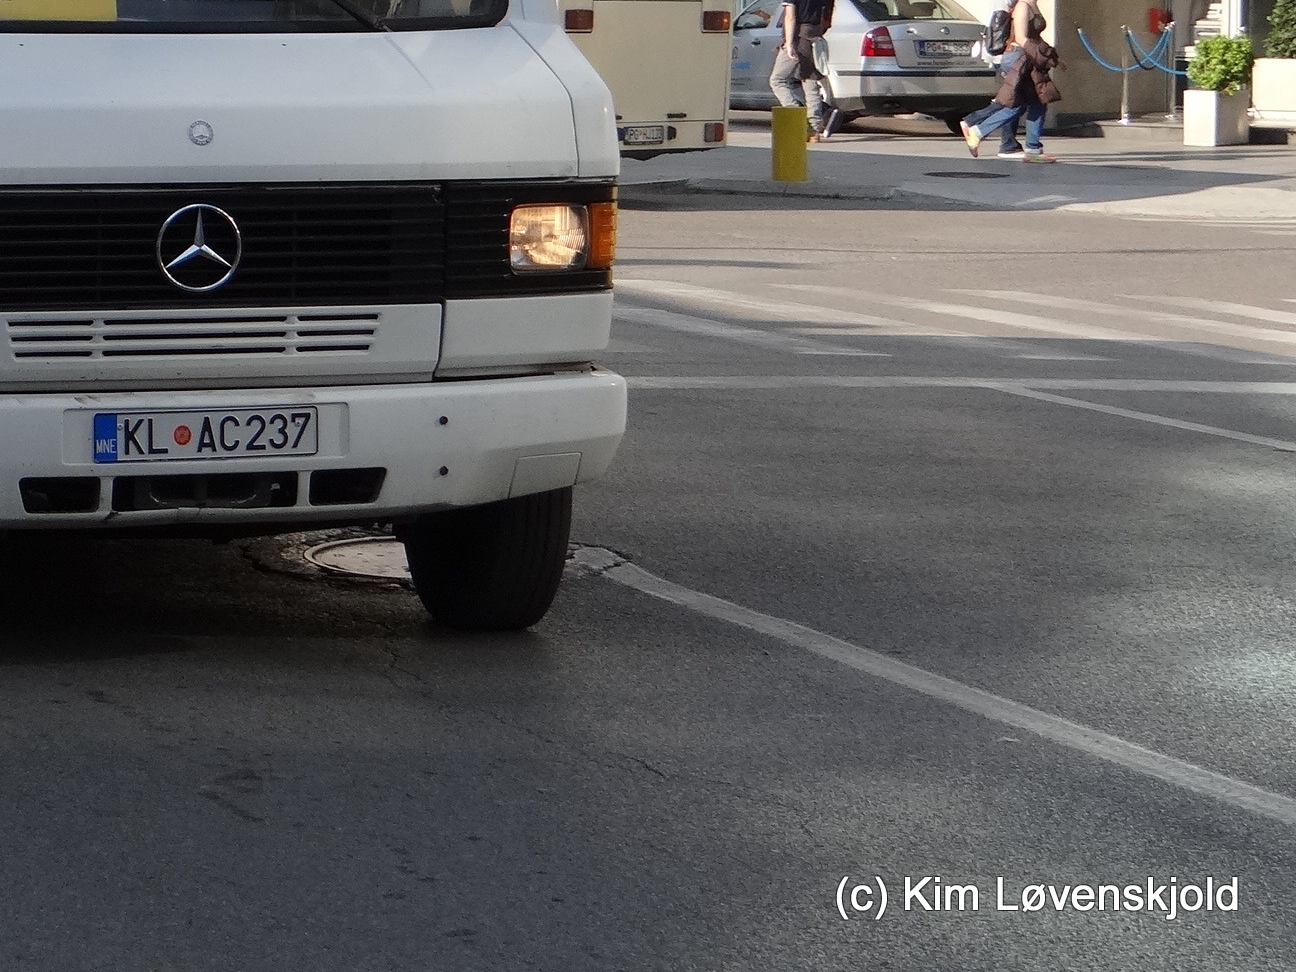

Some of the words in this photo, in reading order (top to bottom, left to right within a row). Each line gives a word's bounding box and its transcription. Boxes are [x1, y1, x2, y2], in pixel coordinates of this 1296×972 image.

[95, 438, 117, 454] MNE
[124, 418, 168, 455] KL
[196, 412, 311, 453] AC237
